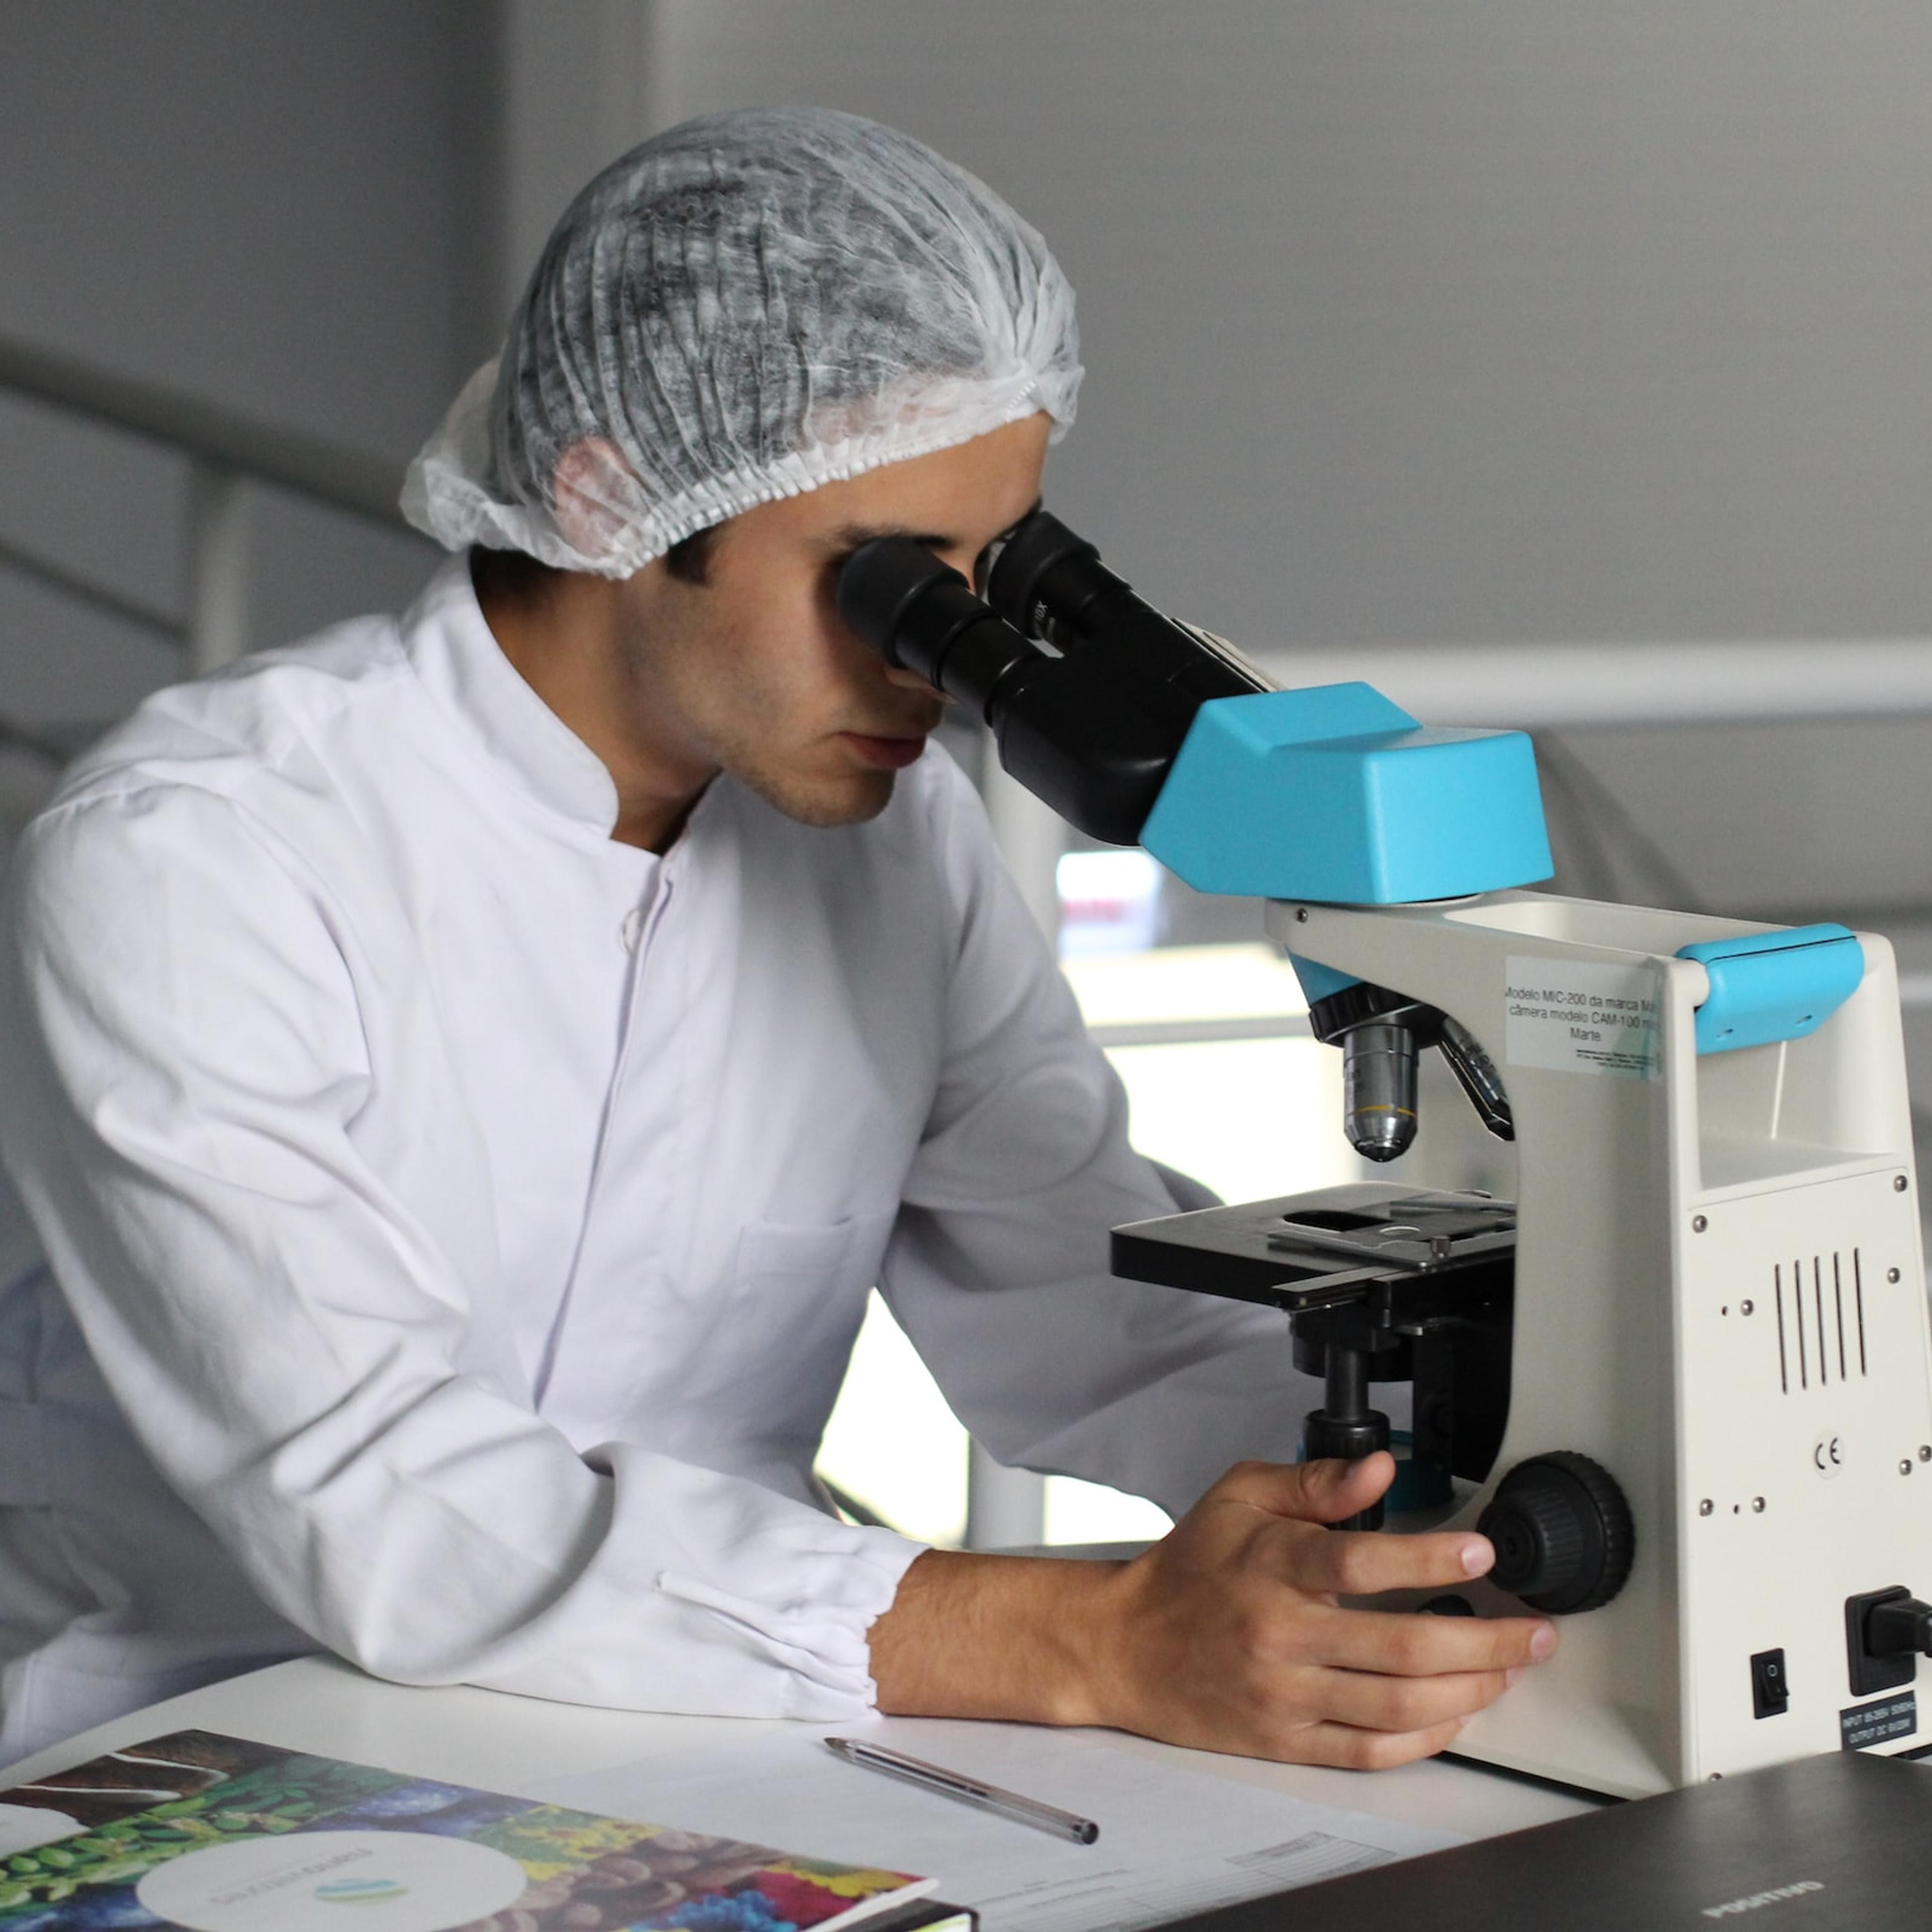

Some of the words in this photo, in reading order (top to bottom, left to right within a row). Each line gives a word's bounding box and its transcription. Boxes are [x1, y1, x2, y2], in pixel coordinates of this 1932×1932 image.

[1543, 990, 1586, 1006] MIC-200
[1589, 996, 1603, 1007] da
[1605, 998, 1639, 1011] marca
[1509, 1004, 1547, 1019] câmera
[1550, 1009, 1588, 1023] modelo
[1591, 1011, 1640, 1028] CAM-100
[1701, 1881, 1825, 1918] POSITIVO
